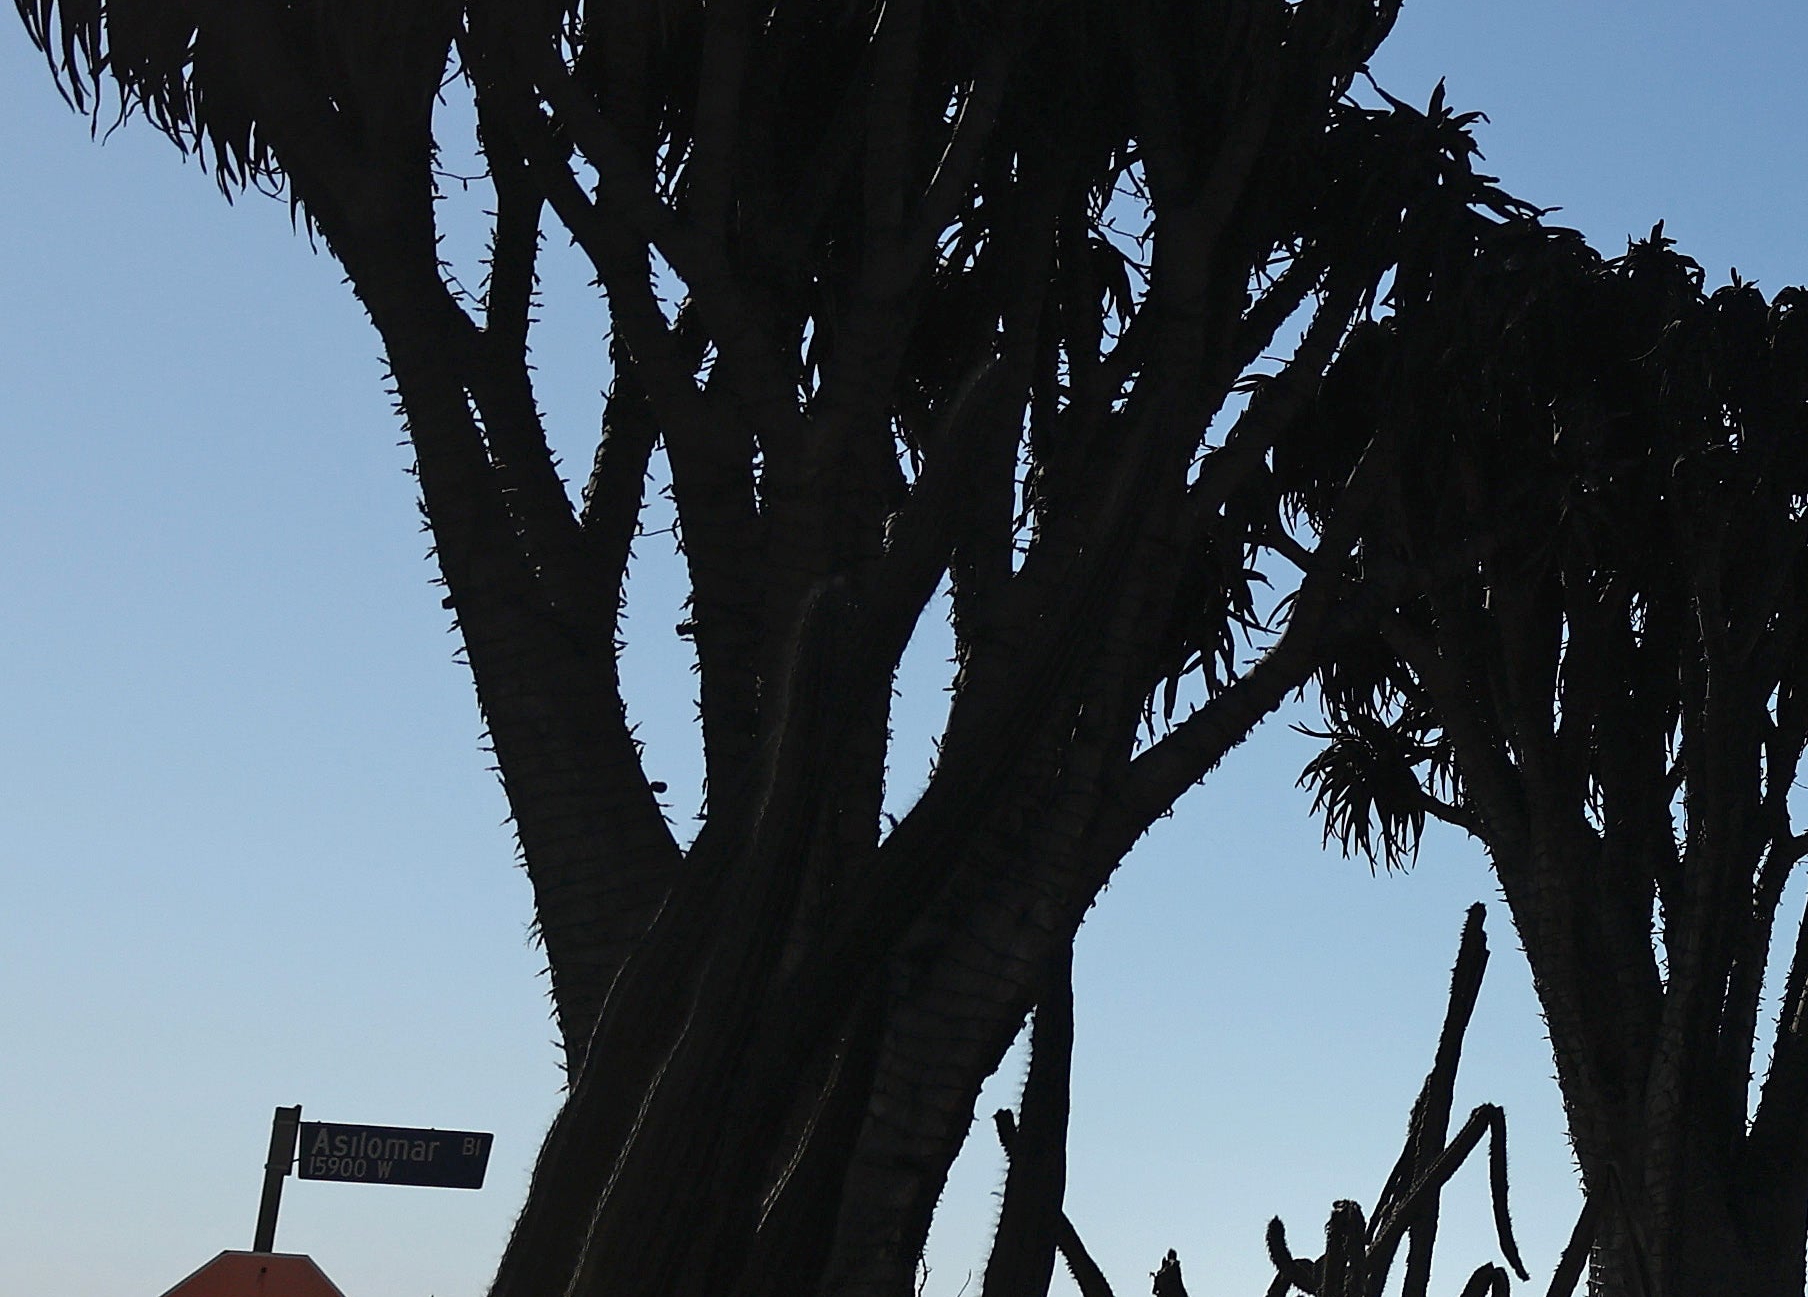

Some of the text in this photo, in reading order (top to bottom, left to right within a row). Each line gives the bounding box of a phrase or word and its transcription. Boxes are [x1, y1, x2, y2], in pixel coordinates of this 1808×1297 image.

[312, 1128, 481, 1161] Asilomar Bl
[309, 1156, 393, 1179] 15900 W
